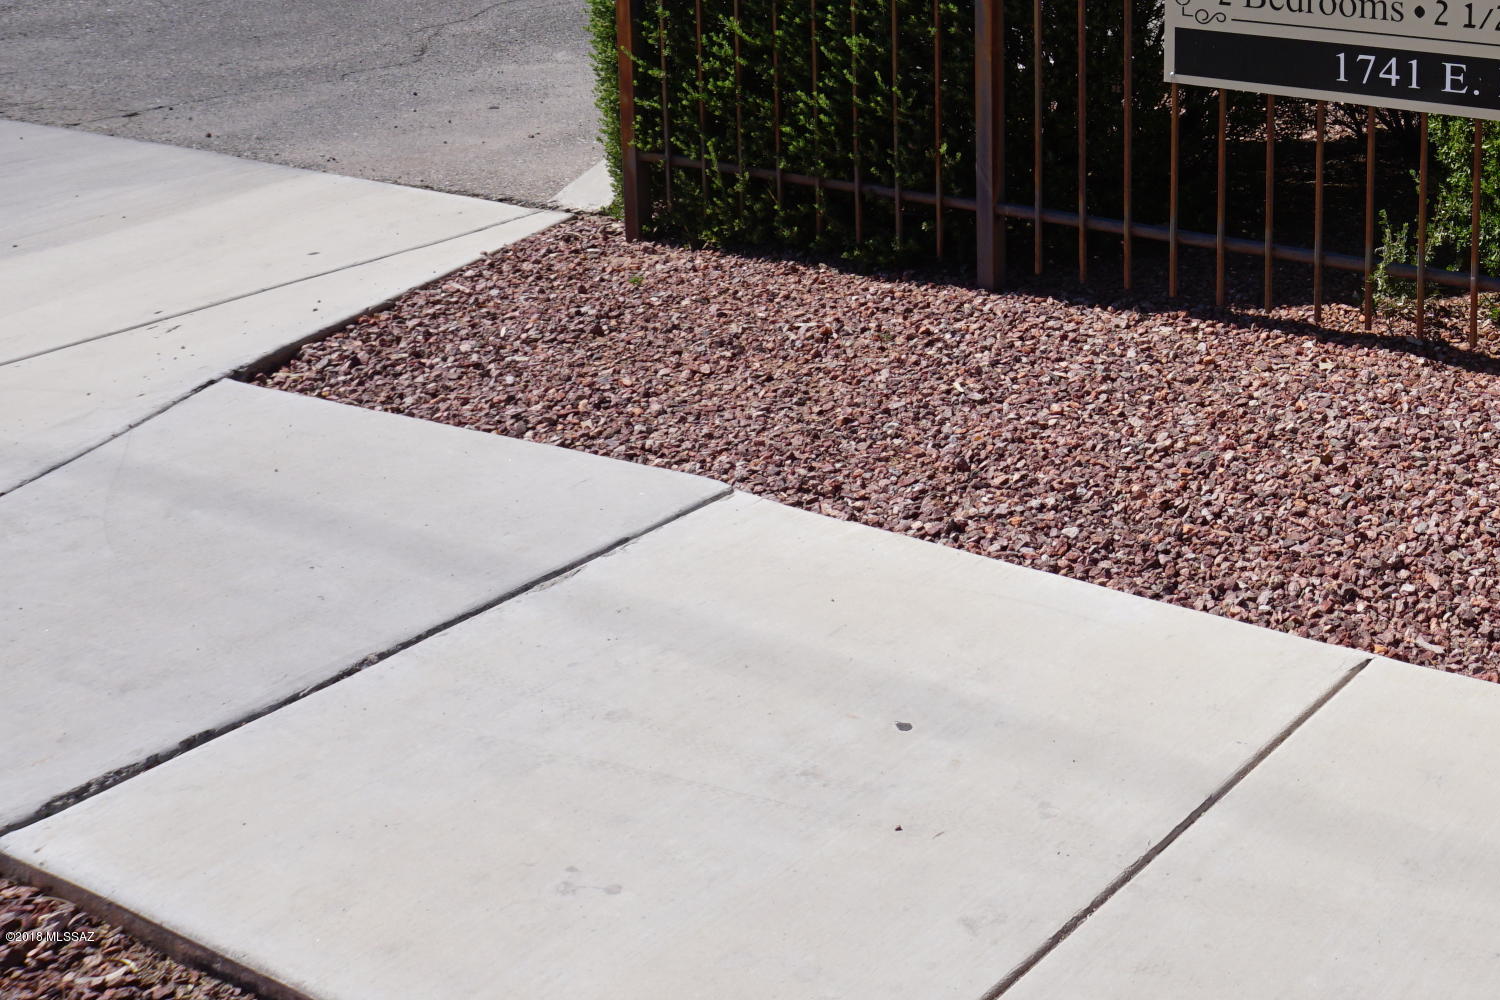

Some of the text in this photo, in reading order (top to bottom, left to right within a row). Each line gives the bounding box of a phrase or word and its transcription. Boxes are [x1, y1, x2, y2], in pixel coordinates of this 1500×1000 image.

[1434, 0, 1448, 26] 2
[1335, 52, 1422, 89] 1741
[1441, 62, 1481, 96] E.
